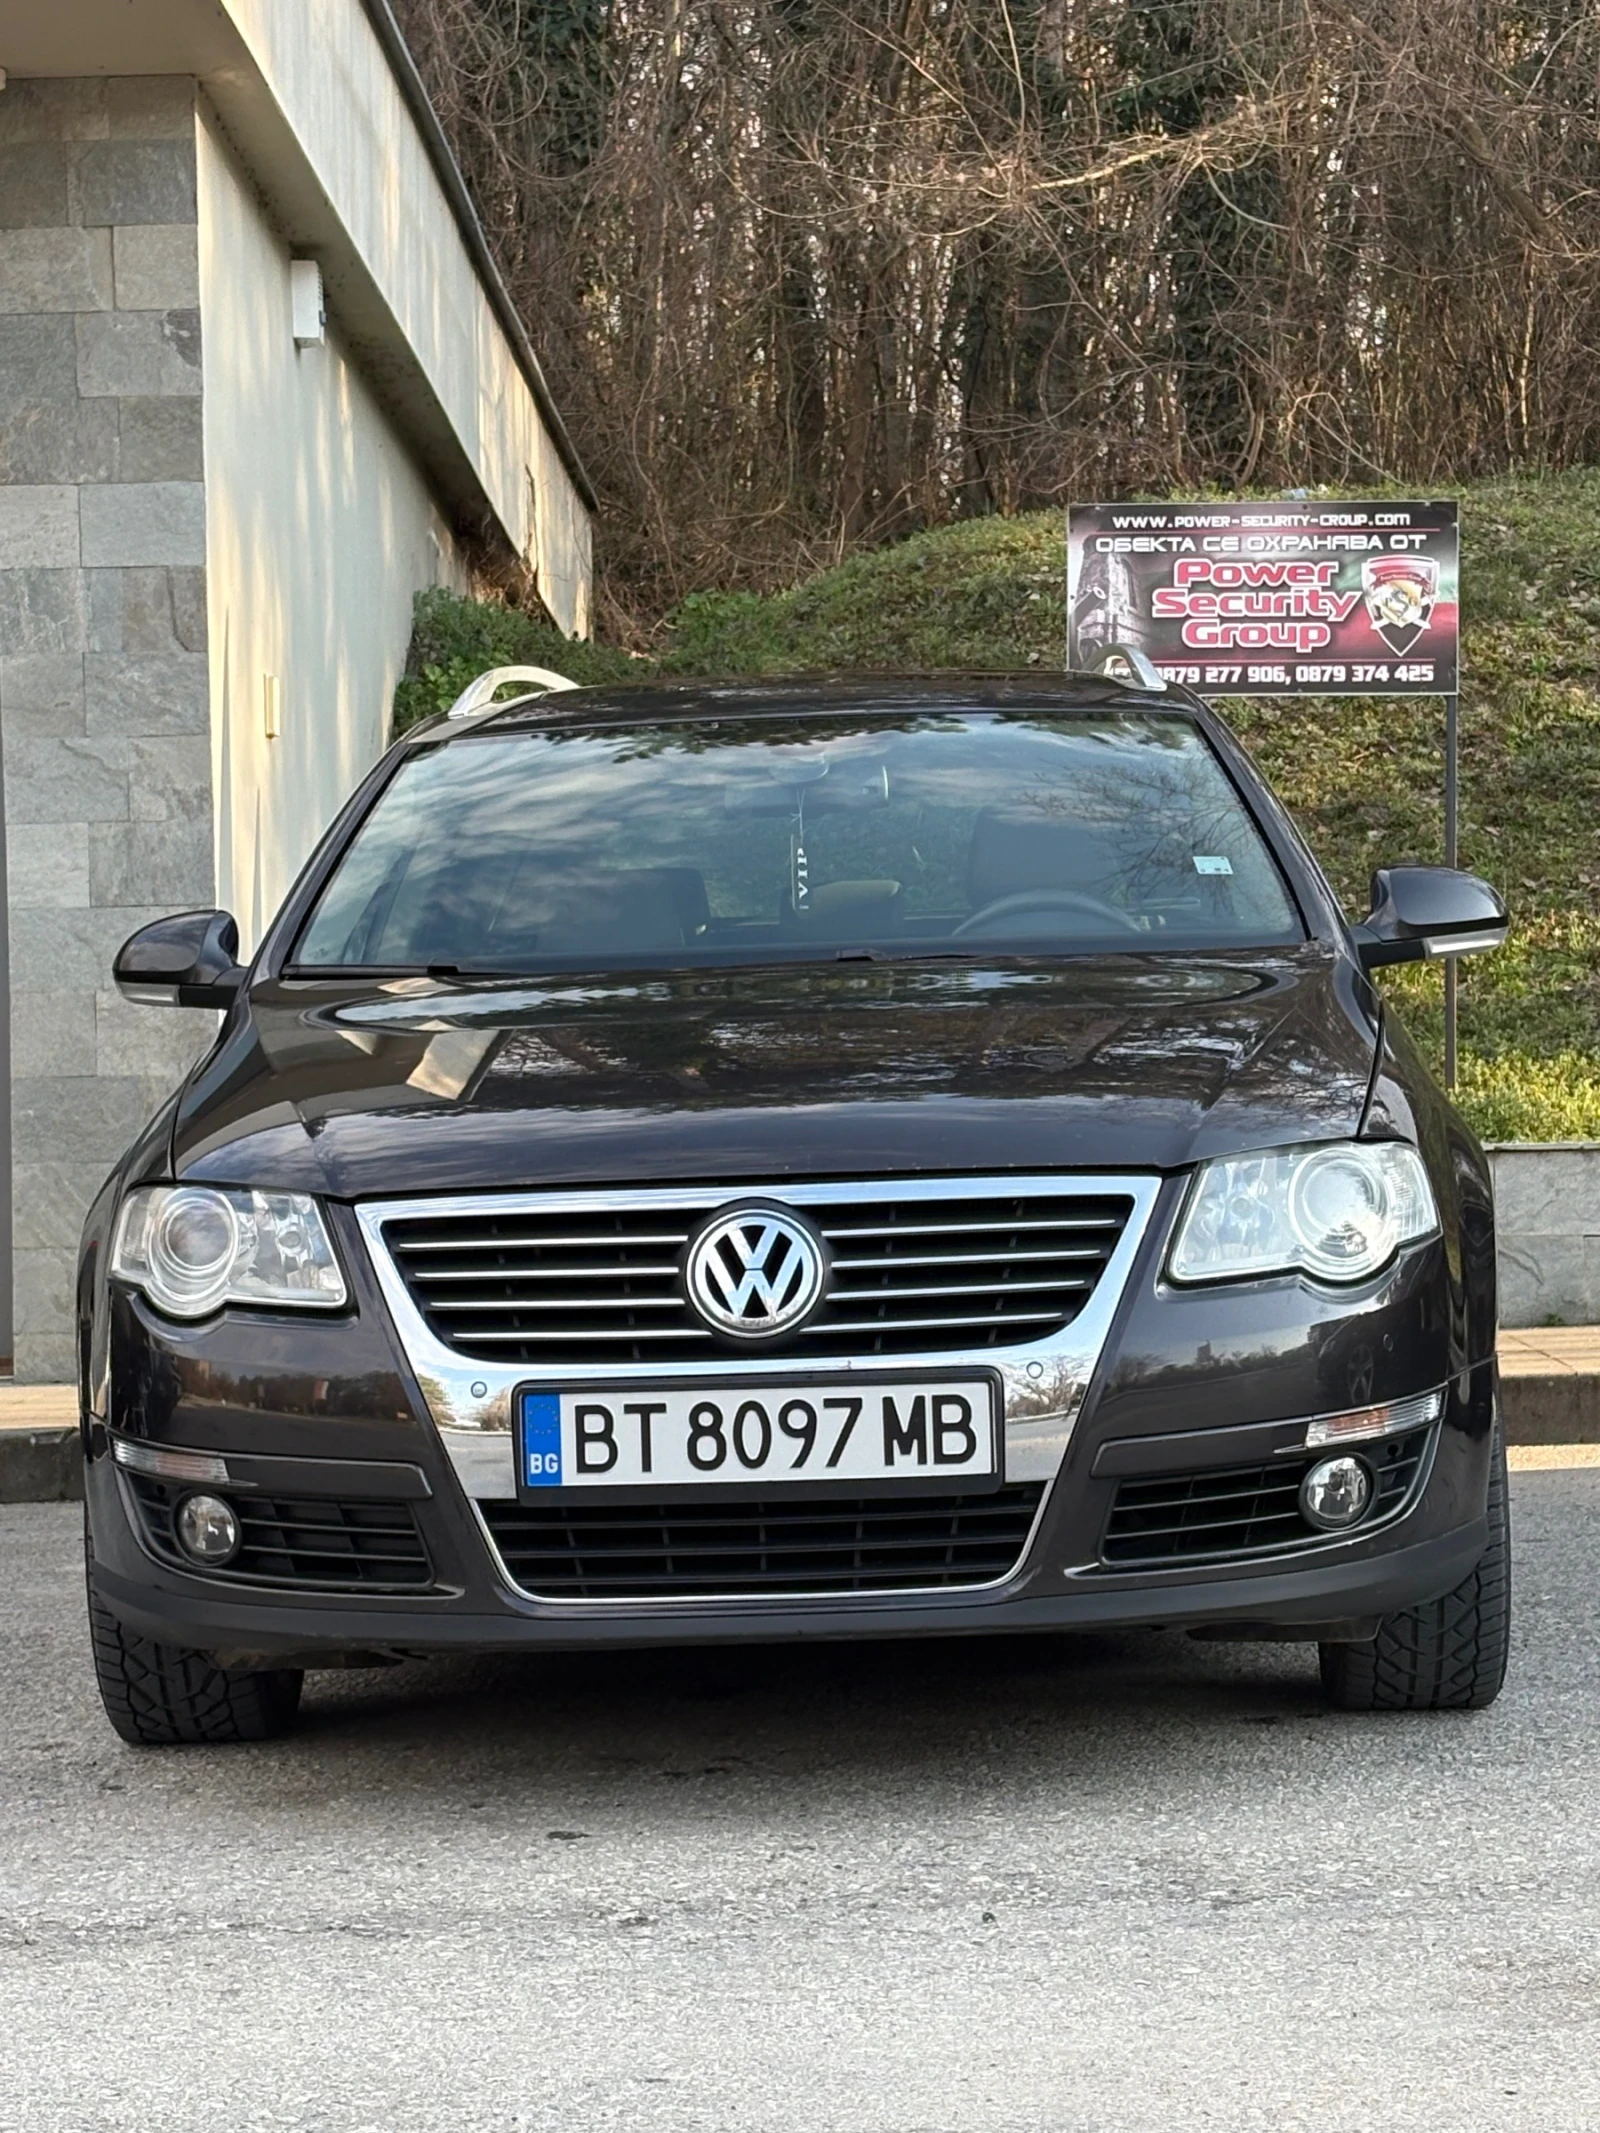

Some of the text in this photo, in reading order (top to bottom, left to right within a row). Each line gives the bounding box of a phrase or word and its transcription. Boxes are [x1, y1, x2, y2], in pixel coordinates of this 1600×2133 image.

[1095, 537, 1197, 553] ОБЕКТА
[1203, 536, 1239, 552] СЕ
[1389, 534, 1427, 550] ОТ
[1173, 558, 1340, 588] Power
[1151, 586, 1362, 622] Security
[1181, 616, 1331, 653] Group
[1205, 666, 1242, 683] 277
[1247, 665, 1292, 685] 906,
[1295, 665, 1346, 682] 0879
[1351, 664, 1389, 682] 374
[1394, 664, 1434, 682] 425
[692, 1213, 818, 1333] VW
[530, 1394, 977, 1474] BG BT 8097 MB
